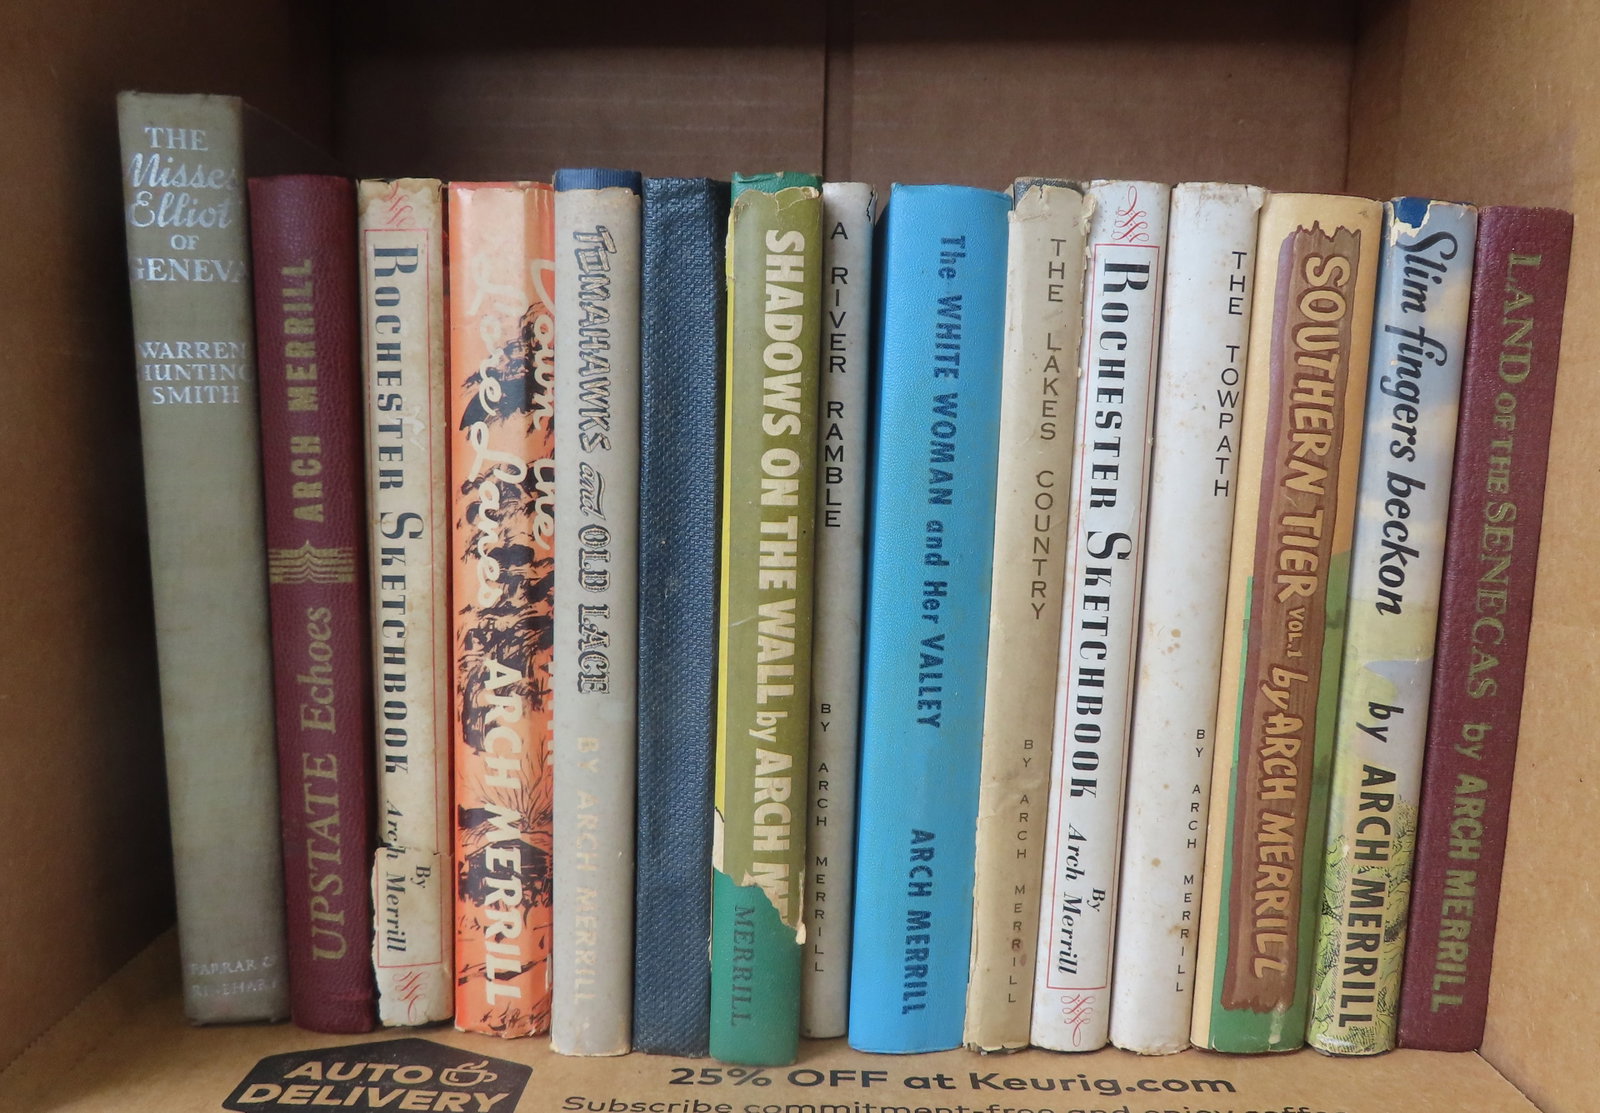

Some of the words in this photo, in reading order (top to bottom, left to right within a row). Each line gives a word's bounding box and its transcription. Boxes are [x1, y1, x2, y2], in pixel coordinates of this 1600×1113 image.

[145, 127, 208, 151] THE
[128, 190, 233, 228] Elliot
[170, 234, 200, 250] OF
[830, 222, 849, 240] A
[938, 235, 967, 280] The
[1048, 238, 1067, 303] THE
[1228, 251, 1248, 316] THE
[1396, 231, 1458, 314] Slim
[139, 341, 247, 359] WARREN
[282, 259, 318, 411] MERRILL
[573, 225, 618, 455] TOMAHAWKS
[761, 229, 805, 437] SHADOWS
[829, 267, 849, 374] RIVER
[933, 294, 963, 380] WHITE
[1500, 252, 1542, 385] LAND
[151, 385, 240, 405] SMITH
[373, 244, 418, 490] ROCHESTER
[1039, 332, 1062, 442] LAKES
[1089, 258, 1151, 510] ROCHESTER
[1284, 254, 1352, 496] SOUTHERN
[1380, 325, 1448, 464] fingers
[1492, 391, 1519, 428] OF
[824, 401, 845, 529] RAMBLE
[928, 391, 959, 506] WOMAN
[1213, 344, 1240, 498] TOWPATH
[290, 435, 324, 523] ARCH
[578, 462, 607, 521] and
[760, 448, 802, 506] ON
[1486, 437, 1513, 495] THE
[468, 421, 527, 608] Lanes
[578, 522, 612, 594] OLD
[758, 516, 799, 591] THE
[925, 520, 950, 567] and
[1031, 470, 1055, 620] COUNTRY
[1276, 508, 1323, 604] TIER
[1375, 470, 1426, 617] beckon
[380, 511, 424, 774] SKETCHBOOK
[921, 580, 949, 623] Her
[1465, 499, 1517, 698] SENECAS
[297, 606, 336, 734] Echoes
[577, 603, 612, 695] LACE
[756, 597, 797, 704] WALL
[916, 633, 946, 730] VALLEY
[1069, 530, 1133, 799] SKETCHBOOK
[1260, 664, 1308, 715] by
[483, 656, 523, 790] ARCH
[575, 737, 599, 774] BY
[750, 711, 787, 743] by
[820, 703, 831, 733] BY
[1022, 739, 1033, 768] BY
[1195, 729, 1205, 758] BY
[1259, 712, 1303, 801] ARCH
[1356, 701, 1404, 743] by
[1454, 722, 1492, 758] by
[385, 800, 406, 859] Arch
[575, 790, 599, 873] ARCH
[753, 747, 793, 851] ARCH
[815, 762, 829, 827] ARCH
[1016, 794, 1030, 859] ARCH
[1187, 784, 1201, 849] ARCH
[1353, 764, 1396, 861] ARCH
[1448, 772, 1487, 861] ARCH
[302, 753, 348, 962] UPSTATE
[410, 865, 432, 890] By
[908, 828, 935, 898] ARCH
[1066, 823, 1088, 882] Arch
[1253, 811, 1295, 979] MERRILL
[385, 863, 407, 953] Merrill
[483, 801, 523, 1006] MERRILL
[573, 883, 599, 1005] MERRILL
[814, 856, 828, 973] MERRILL
[1007, 884, 1026, 1004] MERRILL
[1058, 885, 1083, 975] Merrill
[1087, 887, 1106, 913] By
[1175, 874, 1194, 993] MERRILL
[1430, 868, 1477, 1014] MERRILL
[731, 905, 755, 1026] MERRILL
[901, 909, 931, 1016] MERRILL
[1339, 876, 1386, 1028] MERRILL
[236, 1083, 510, 1113] DELIVERY
[283, 1061, 433, 1084] AUTO
[561, 1096, 733, 1113] Subscribe
[669, 1068, 773, 1087] 25%
[787, 1069, 889, 1088] OFF
[903, 1072, 957, 1090] at
[969, 1072, 1237, 1096] Keurig.com
